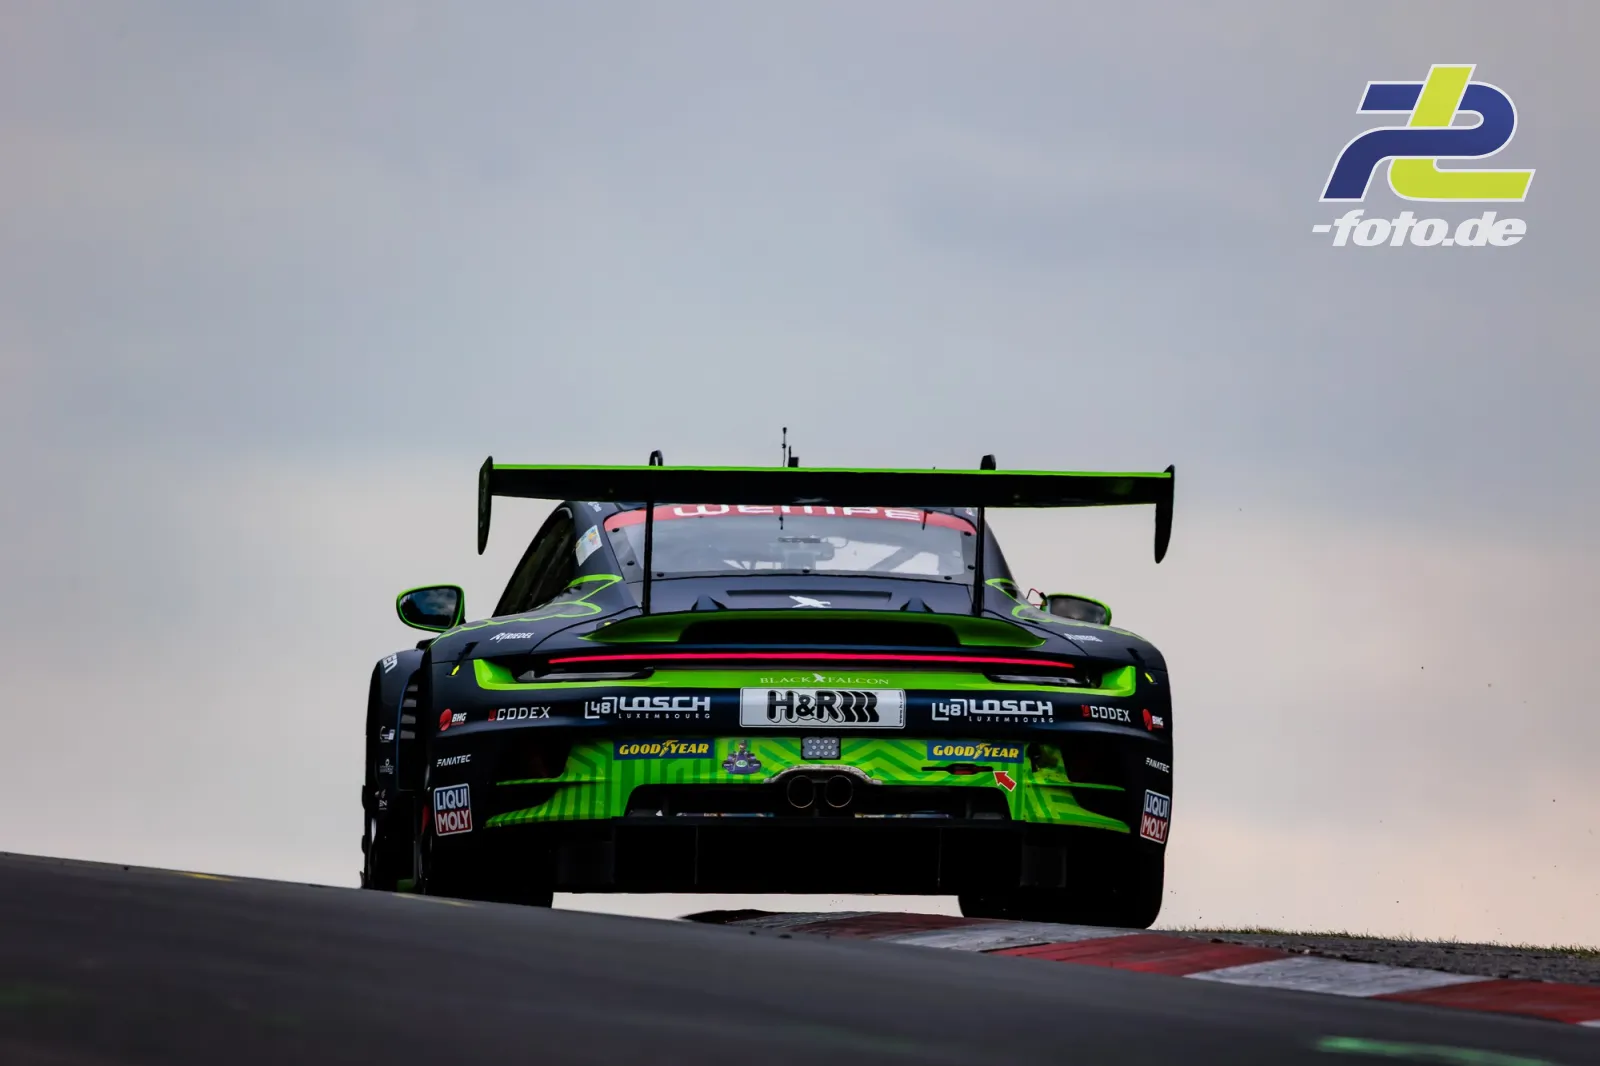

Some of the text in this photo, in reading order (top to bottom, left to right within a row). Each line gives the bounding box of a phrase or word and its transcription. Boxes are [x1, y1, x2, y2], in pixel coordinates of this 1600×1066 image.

[760, 676, 889, 685] BLACK FALCON
[619, 697, 710, 711] LOSCH
[969, 699, 1053, 715] LOSCH
[496, 707, 551, 720] CODEX
[1090, 705, 1131, 722] CODEX
[436, 754, 471, 767] FANATEC
[1145, 757, 1170, 773] FANATEC
[436, 788, 468, 810] LIQUI
[1145, 794, 1168, 818] LIQUI
[437, 809, 469, 832] MOLY
[1142, 815, 1167, 840] MOLY
